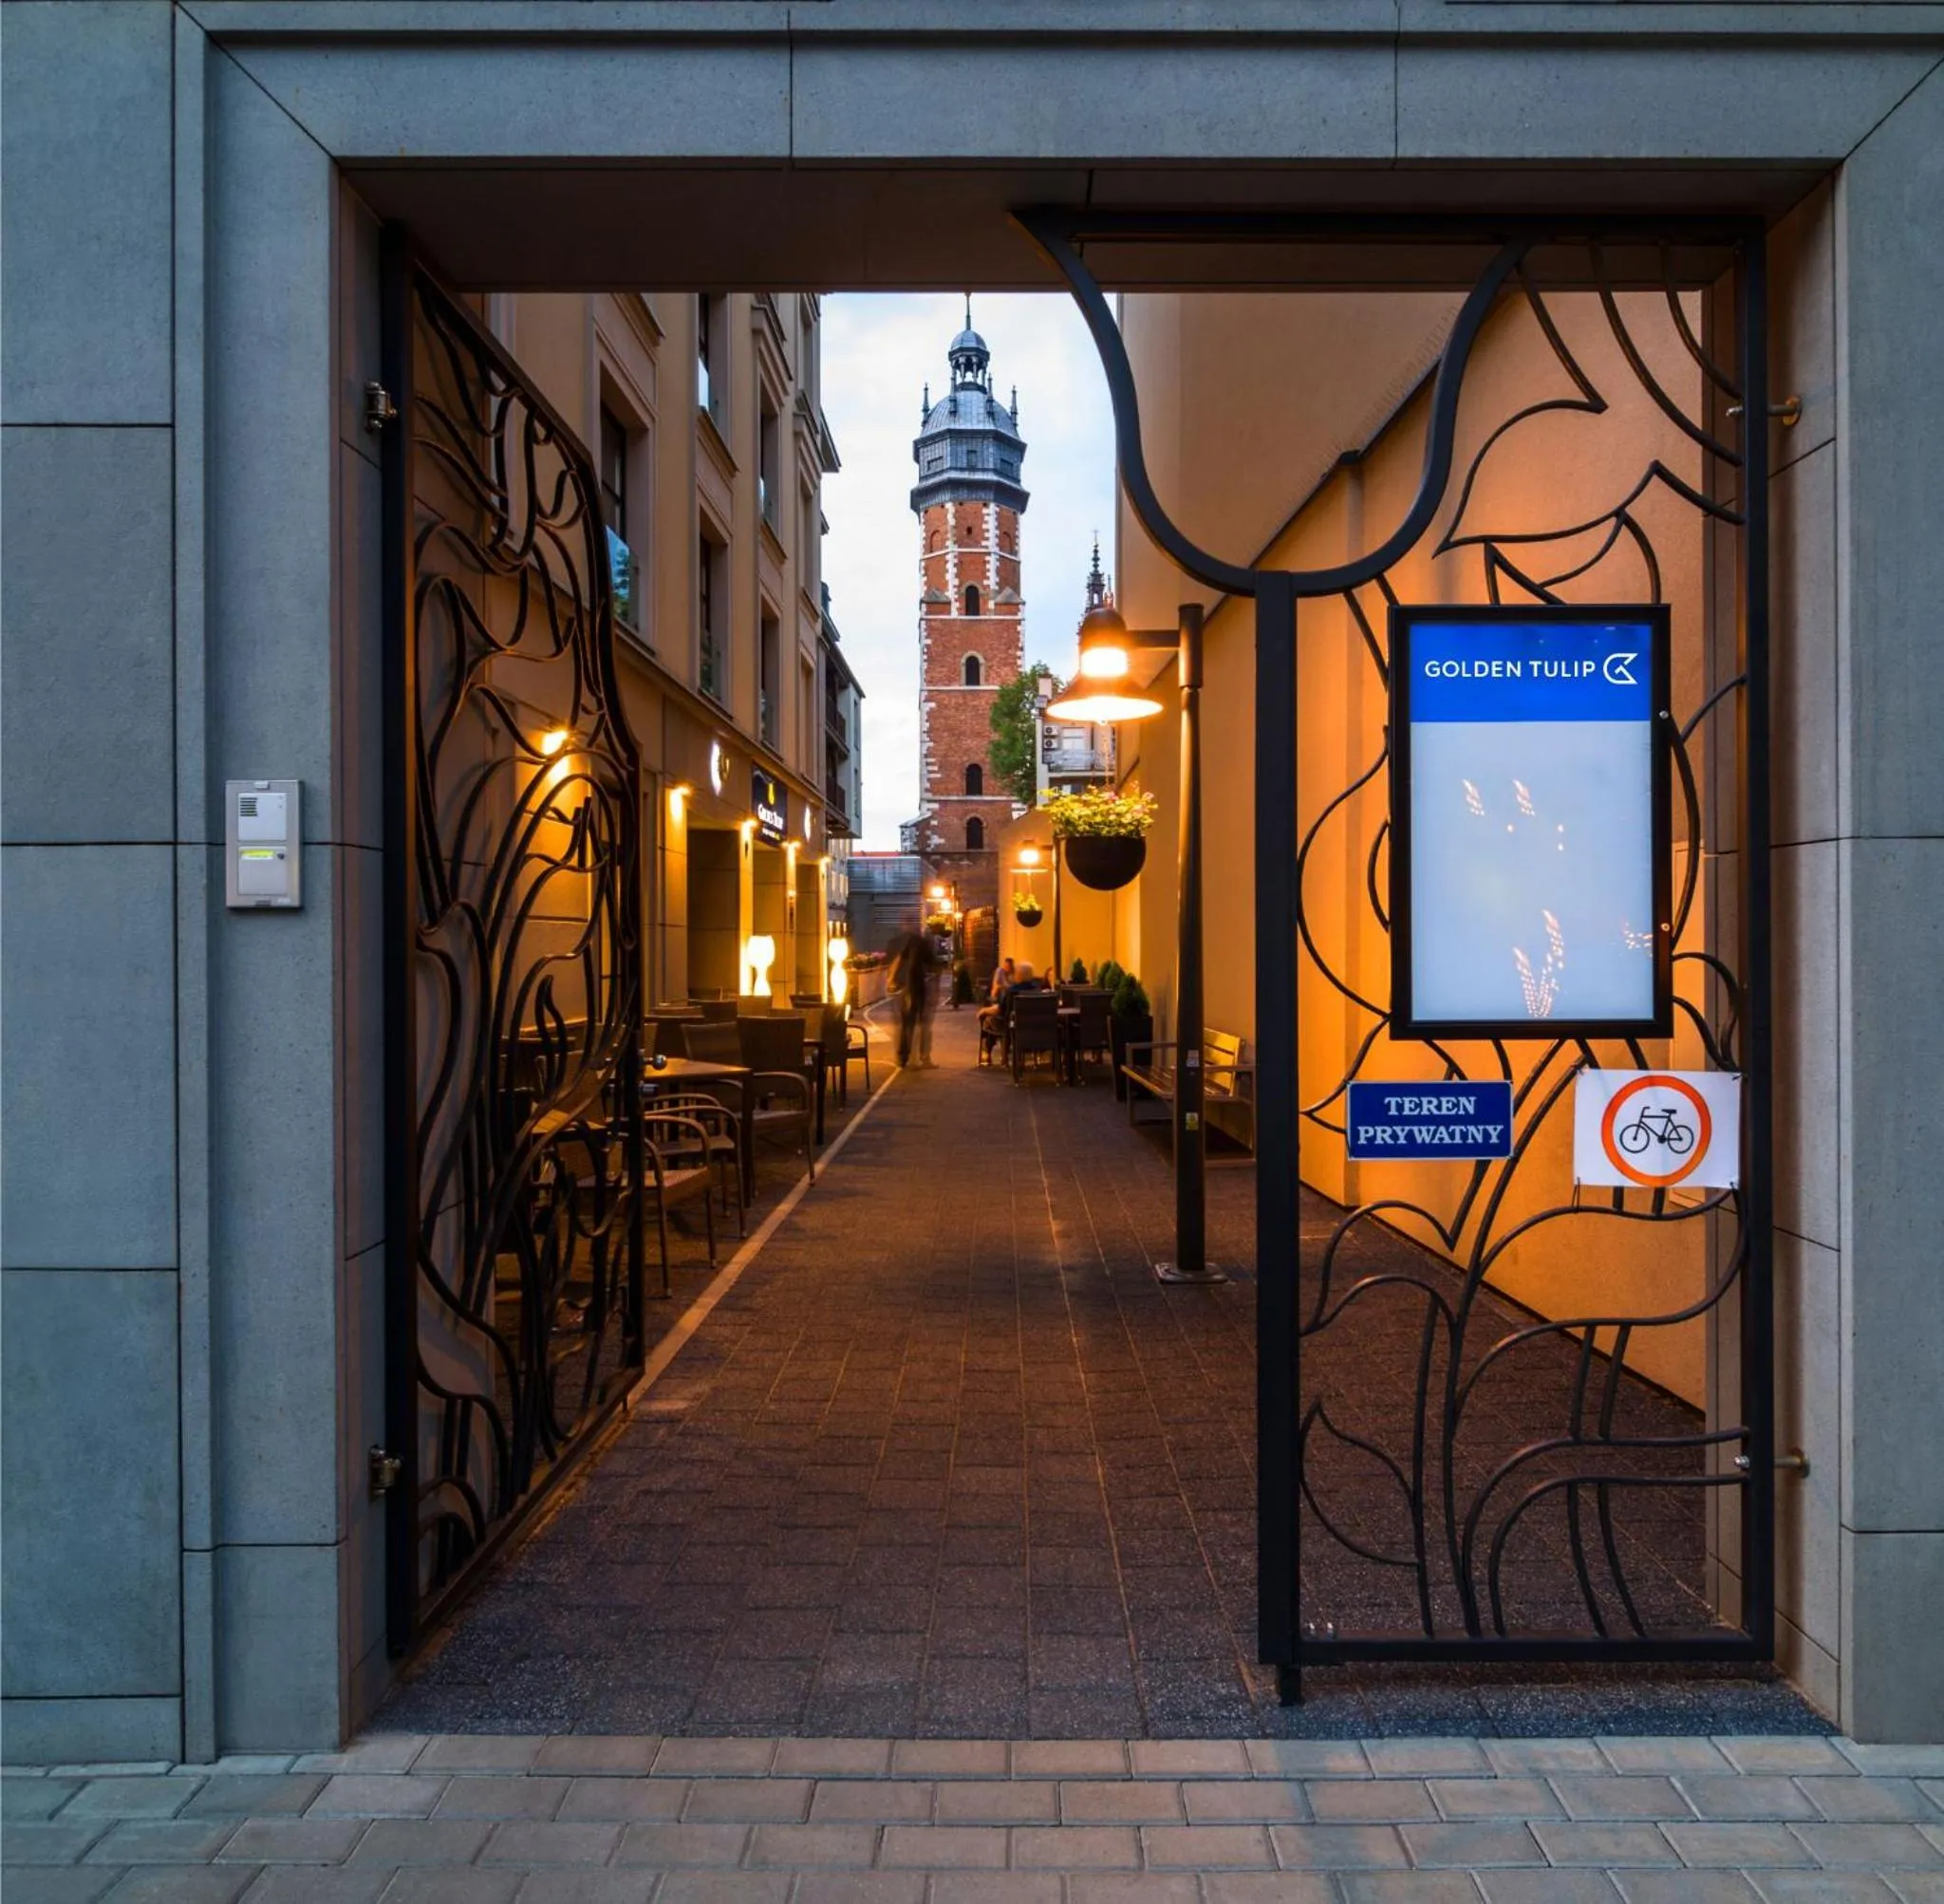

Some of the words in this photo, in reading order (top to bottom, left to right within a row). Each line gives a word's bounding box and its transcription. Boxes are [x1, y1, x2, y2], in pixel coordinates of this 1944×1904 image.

[1425, 661, 1522, 678] GOLDEN
[1529, 661, 1596, 678] TULIP
[1384, 1096, 1477, 1116] TEREN
[1357, 1125, 1505, 1145] PRYWATNY
